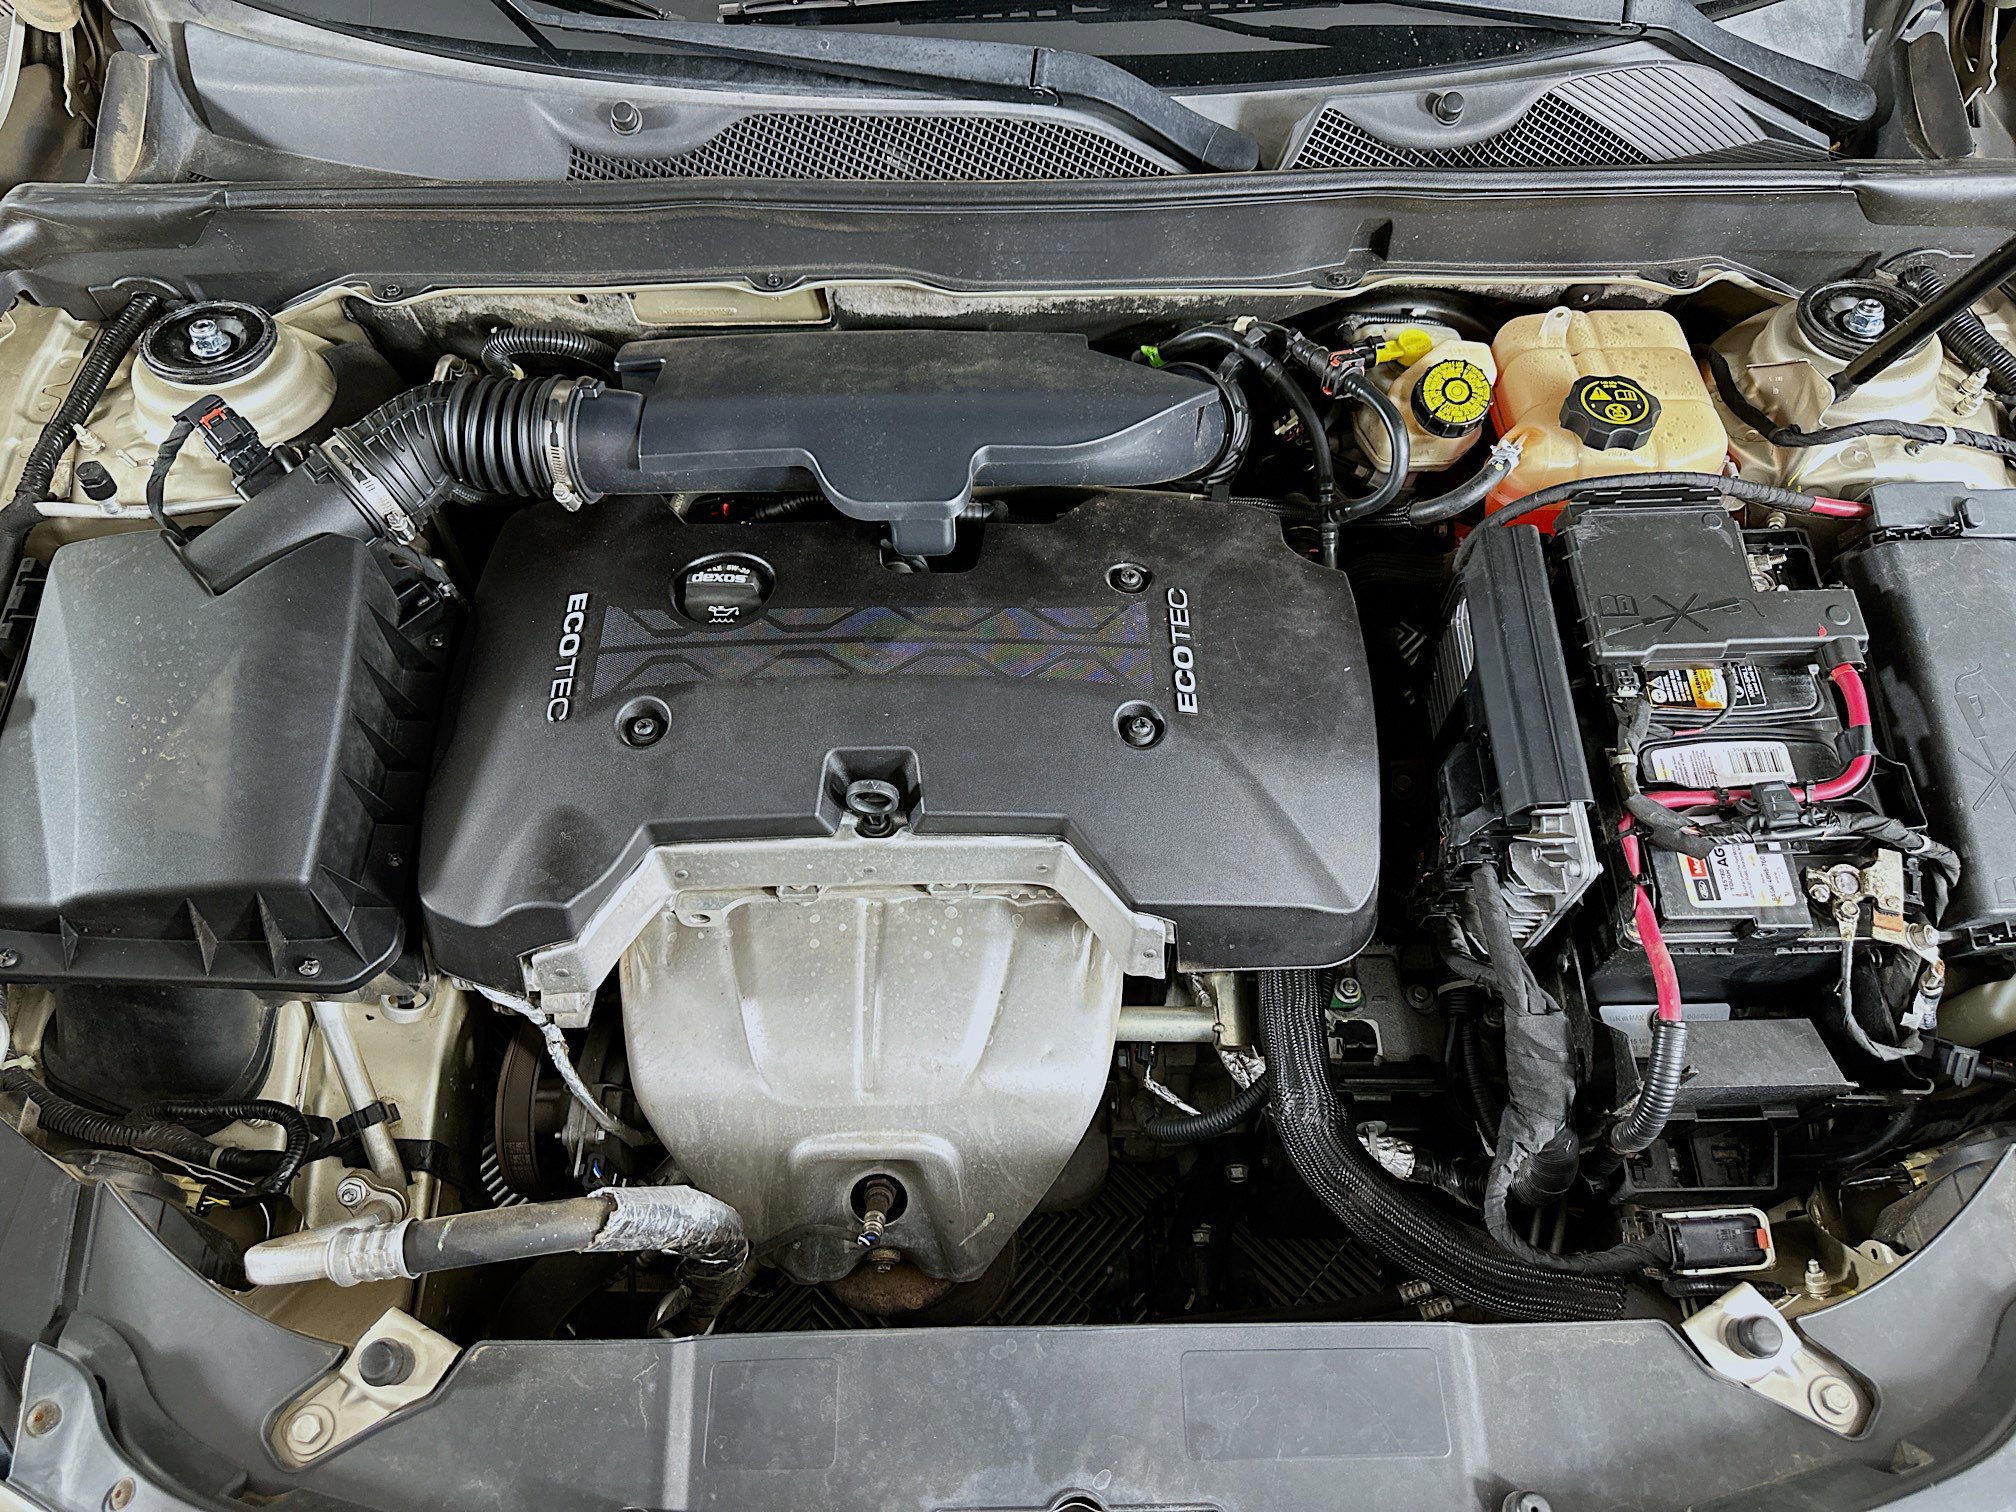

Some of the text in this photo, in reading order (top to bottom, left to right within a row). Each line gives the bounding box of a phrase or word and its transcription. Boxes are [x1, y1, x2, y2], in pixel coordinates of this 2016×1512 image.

[691, 571, 748, 583] dexos
[546, 592, 588, 722] ECOTEC
[1167, 587, 1198, 714] ECOTEC
[1714, 847, 1729, 867] AG
